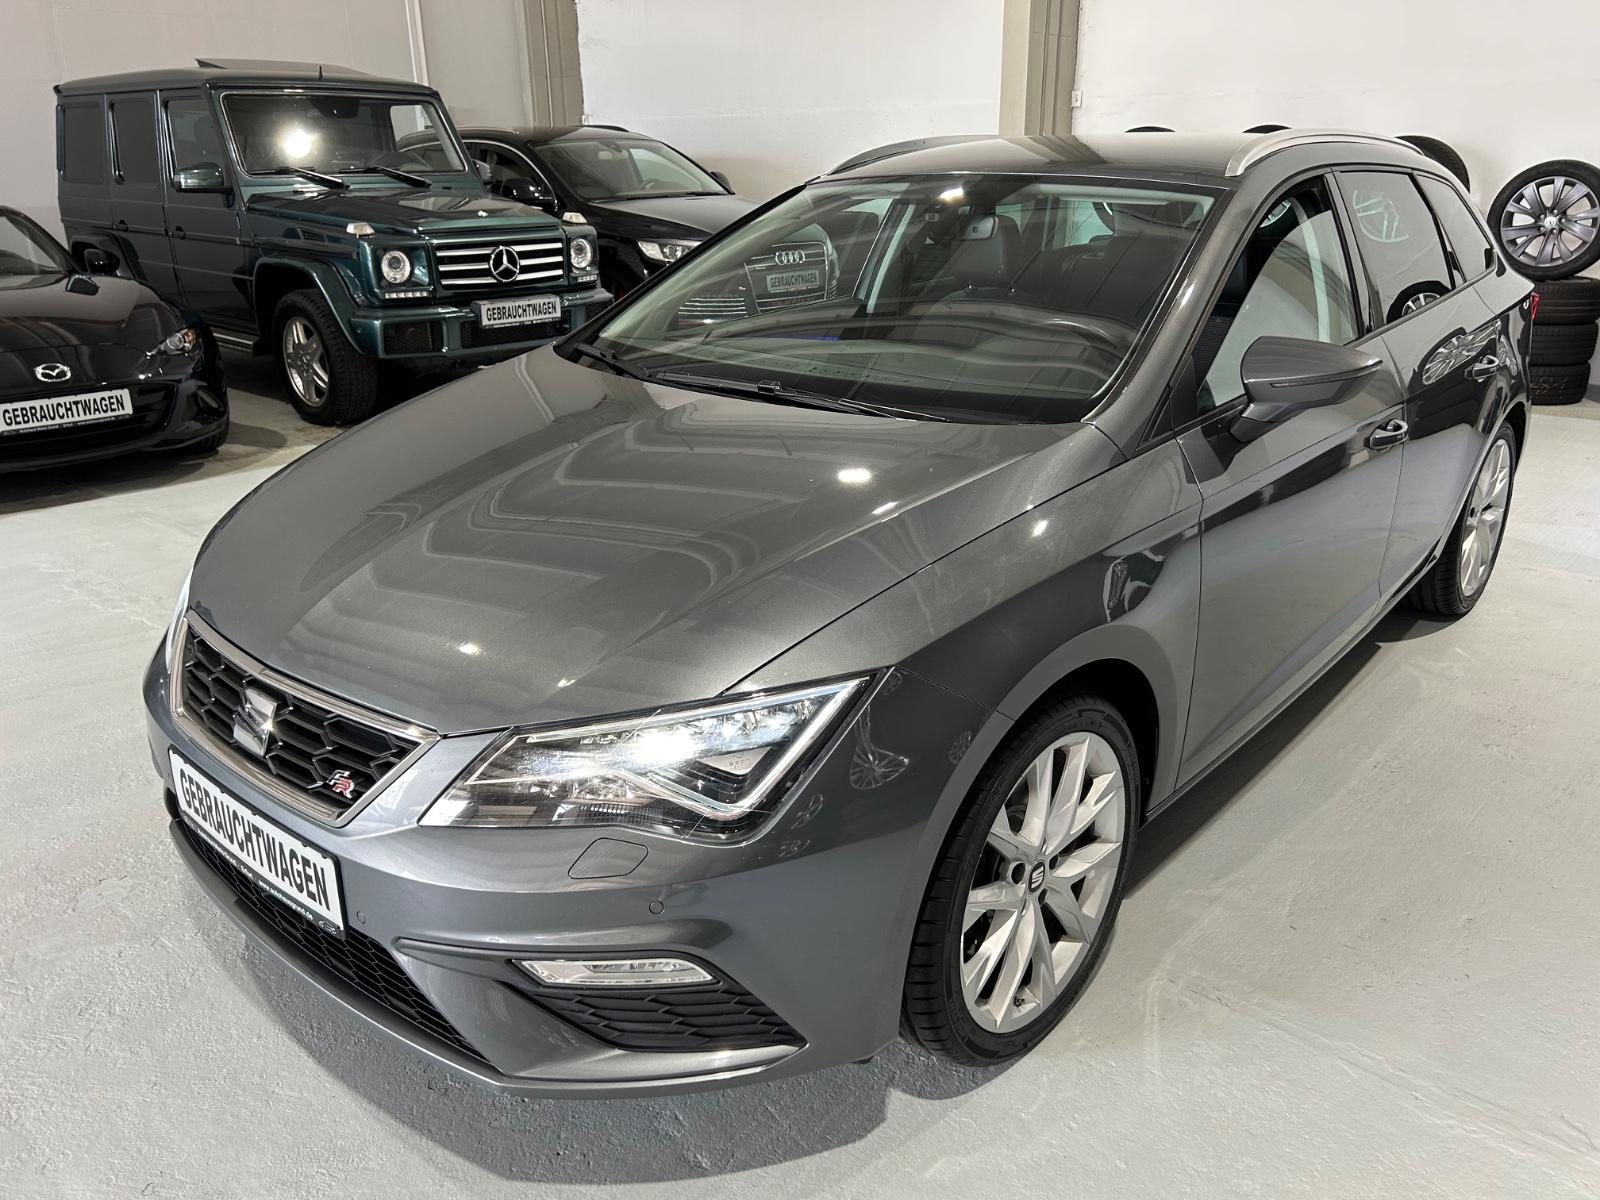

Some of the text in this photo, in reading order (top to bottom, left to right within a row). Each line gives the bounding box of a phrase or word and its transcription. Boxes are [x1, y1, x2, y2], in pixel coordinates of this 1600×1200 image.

[770, 272, 818, 288] GEBRAUCHTWAGEN
[486, 301, 557, 321] GEBRAUCHTWAGEN
[2, 394, 126, 426] GEBRAUCHTWAGEN
[179, 768, 331, 911] GEBRAUCHTWAGEN
